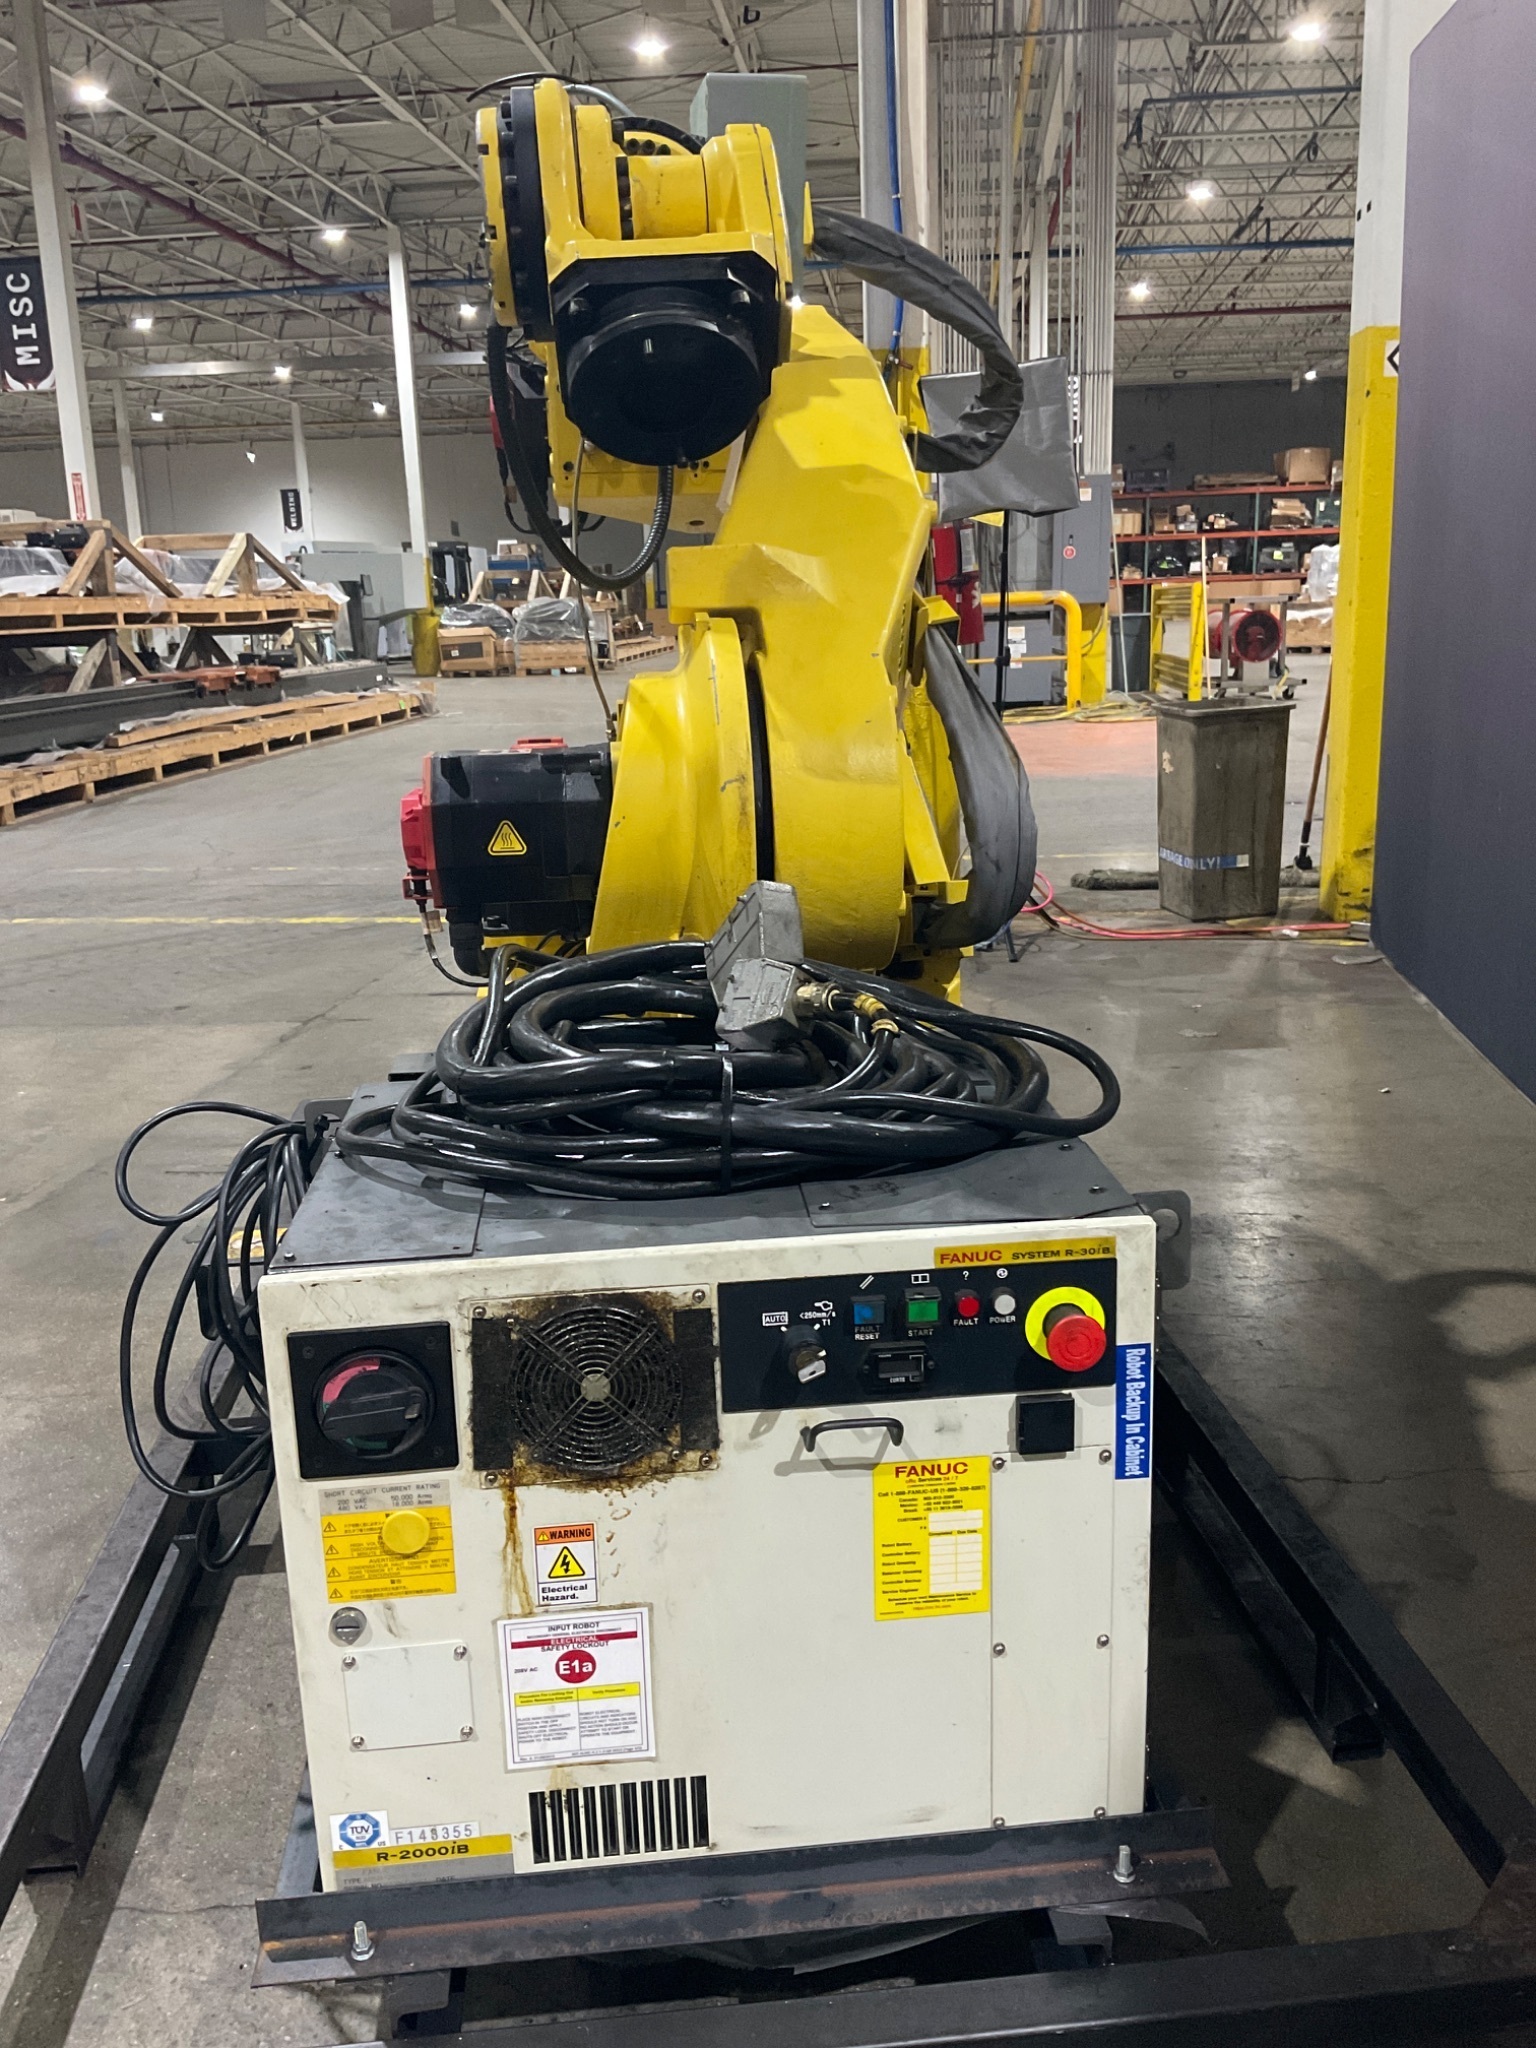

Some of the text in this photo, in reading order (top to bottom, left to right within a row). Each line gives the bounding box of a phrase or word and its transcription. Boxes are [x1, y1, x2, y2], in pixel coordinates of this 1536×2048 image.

[6, 272, 41, 365] MISC
[940, 1244, 1110, 1264] FANUC SYSTEM R-30iB
[954, 1318, 978, 1326] FAULT
[989, 1315, 1016, 1324] POWER
[855, 1325, 880, 1333] FAULT
[908, 1329, 934, 1337] START
[1121, 1348, 1146, 1476] Robot Backup In Cabinet
[895, 1462, 968, 1478] FANUC
[324, 1490, 345, 1498] SHORT
[350, 1488, 377, 1496] CIRCUIT
[381, 1485, 412, 1494] CURRENT
[549, 1528, 591, 1540] WARNING
[541, 1584, 587, 1594] Electrical
[542, 1593, 579, 1602] Hazard.
[548, 1622, 600, 1632] INPUT ROBOT
[550, 1635, 598, 1645] ELECTRICAL
[541, 1641, 609, 1652] SAFETY LOCKOUT
[559, 1660, 593, 1674] E1a
[376, 1841, 469, 1862] R-2000iB
